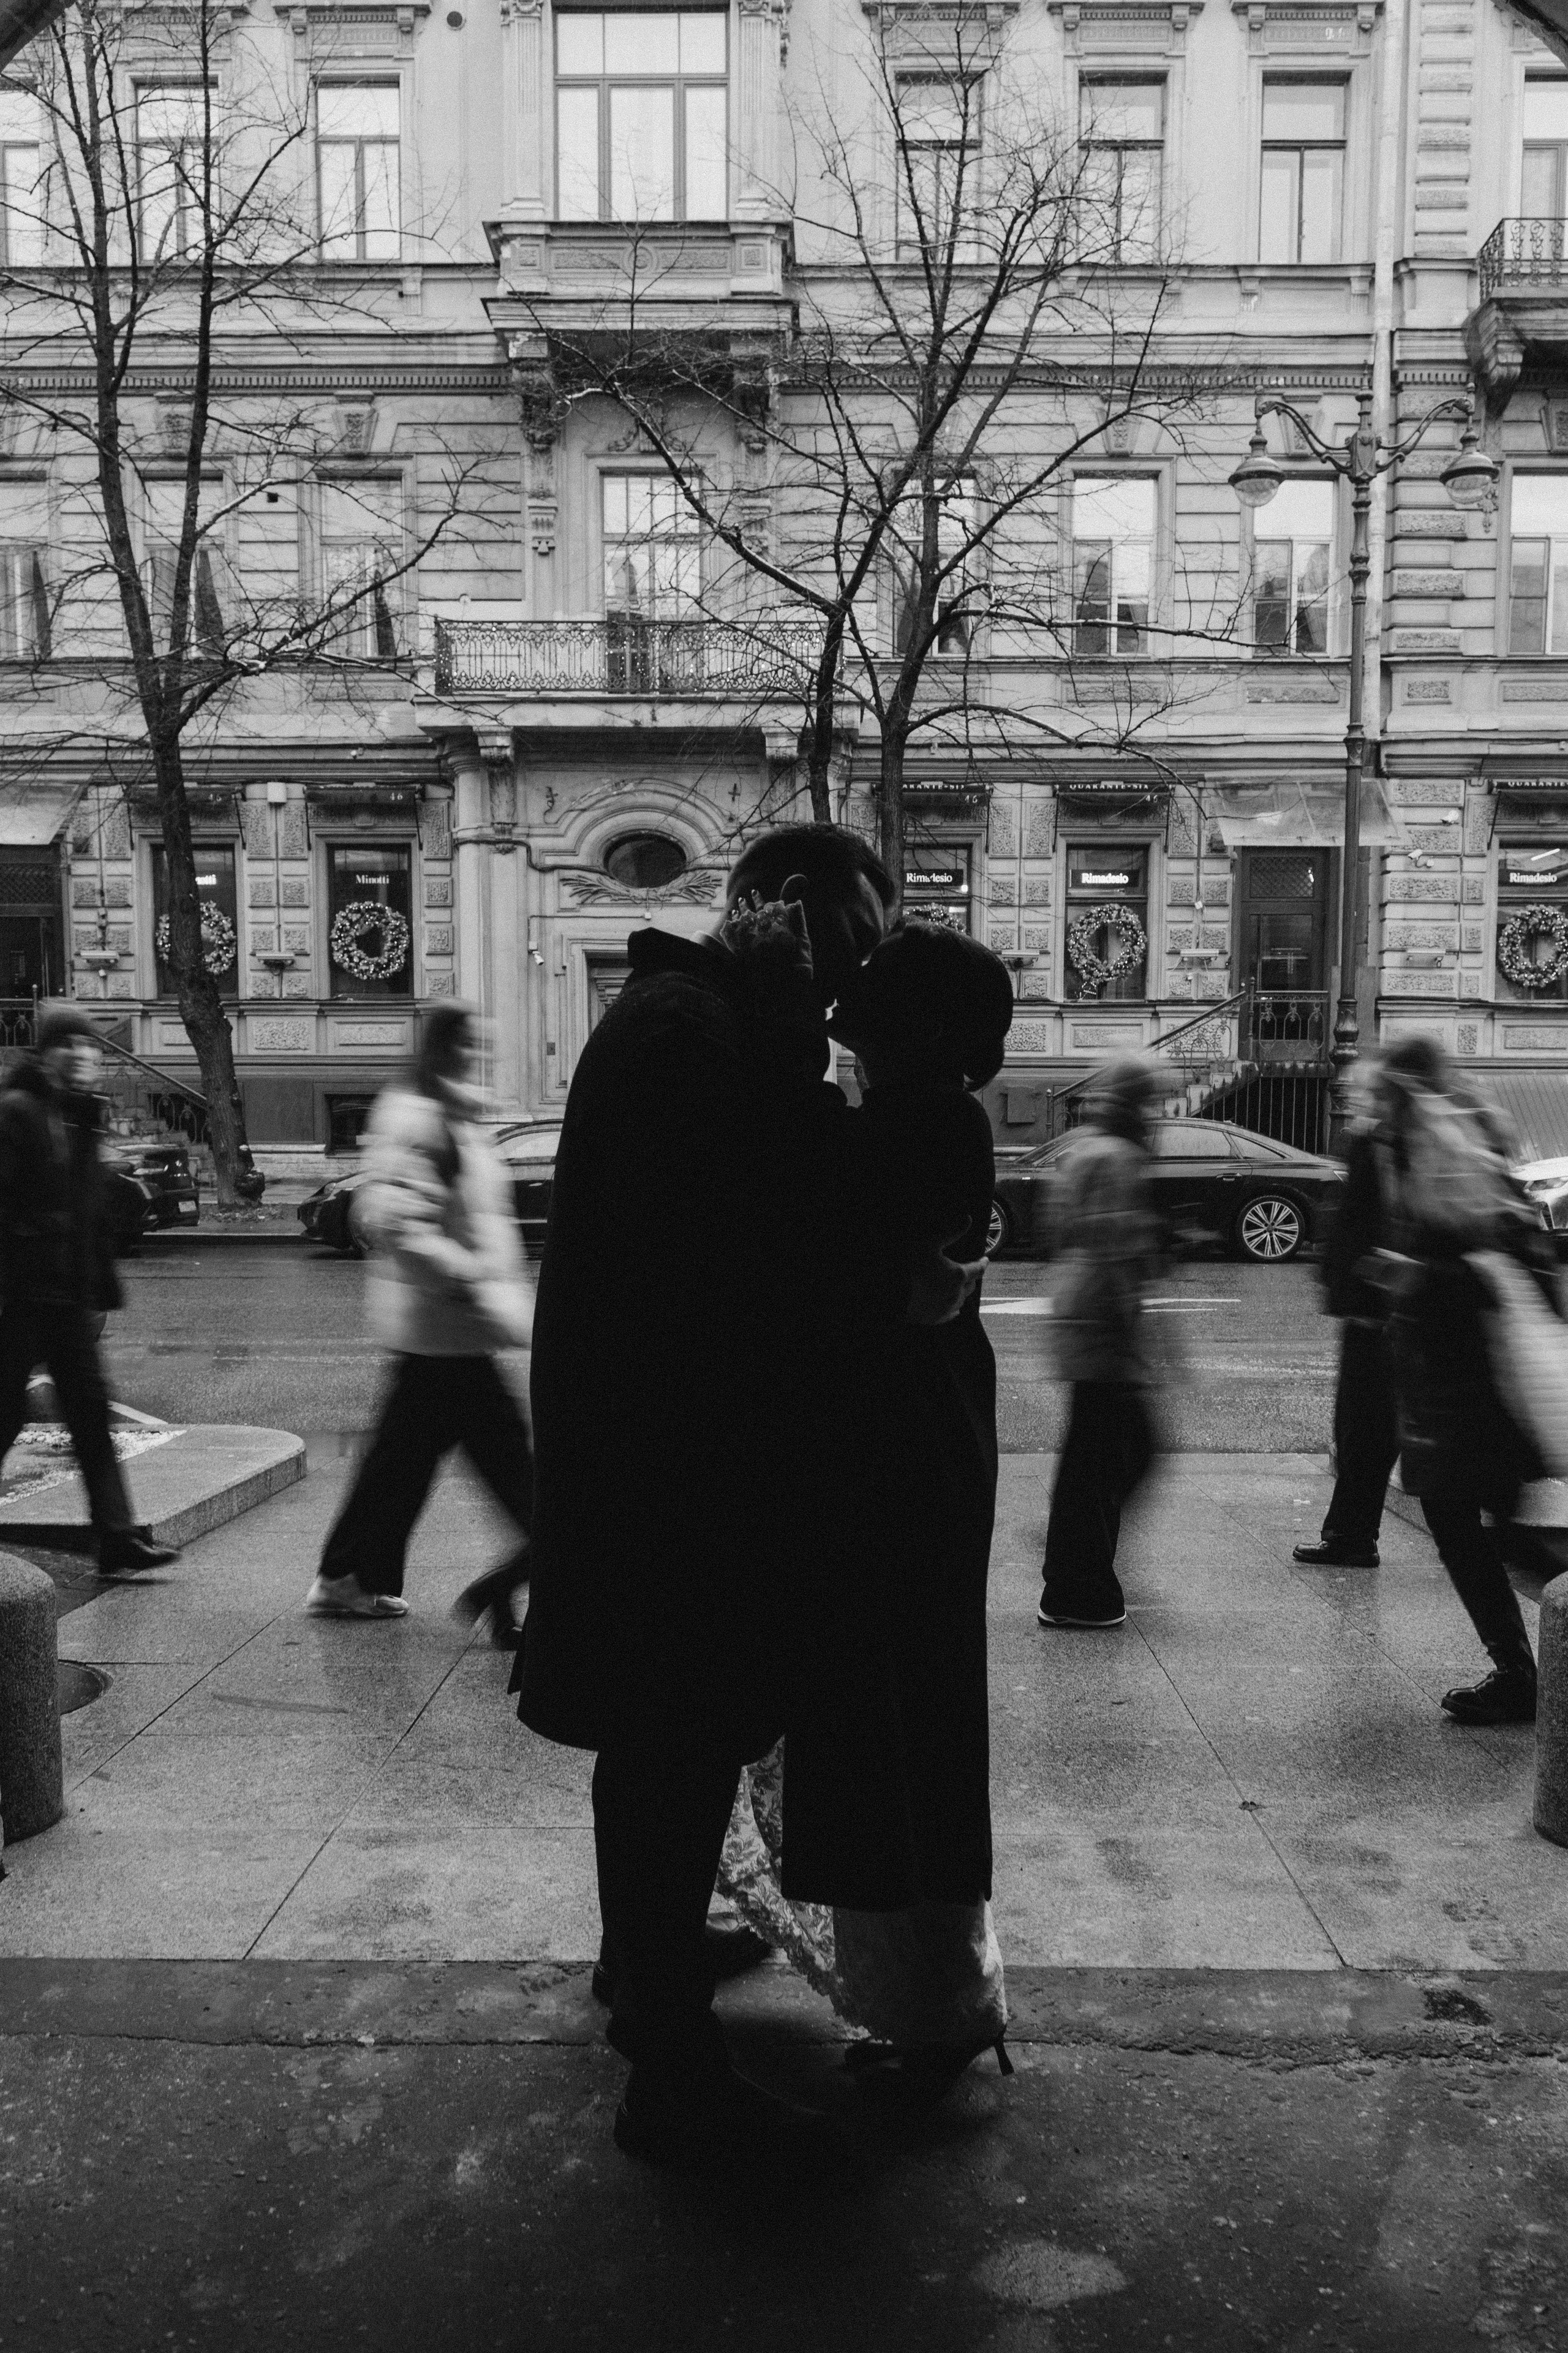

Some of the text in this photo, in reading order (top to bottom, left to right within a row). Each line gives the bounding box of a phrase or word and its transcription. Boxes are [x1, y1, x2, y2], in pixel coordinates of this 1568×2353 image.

[355, 874, 390, 885] Minotti
[906, 872, 953, 883] Rimadesio
[1081, 872, 1129, 885] Rimadesio
[1509, 872, 1558, 884] Rimadesio
